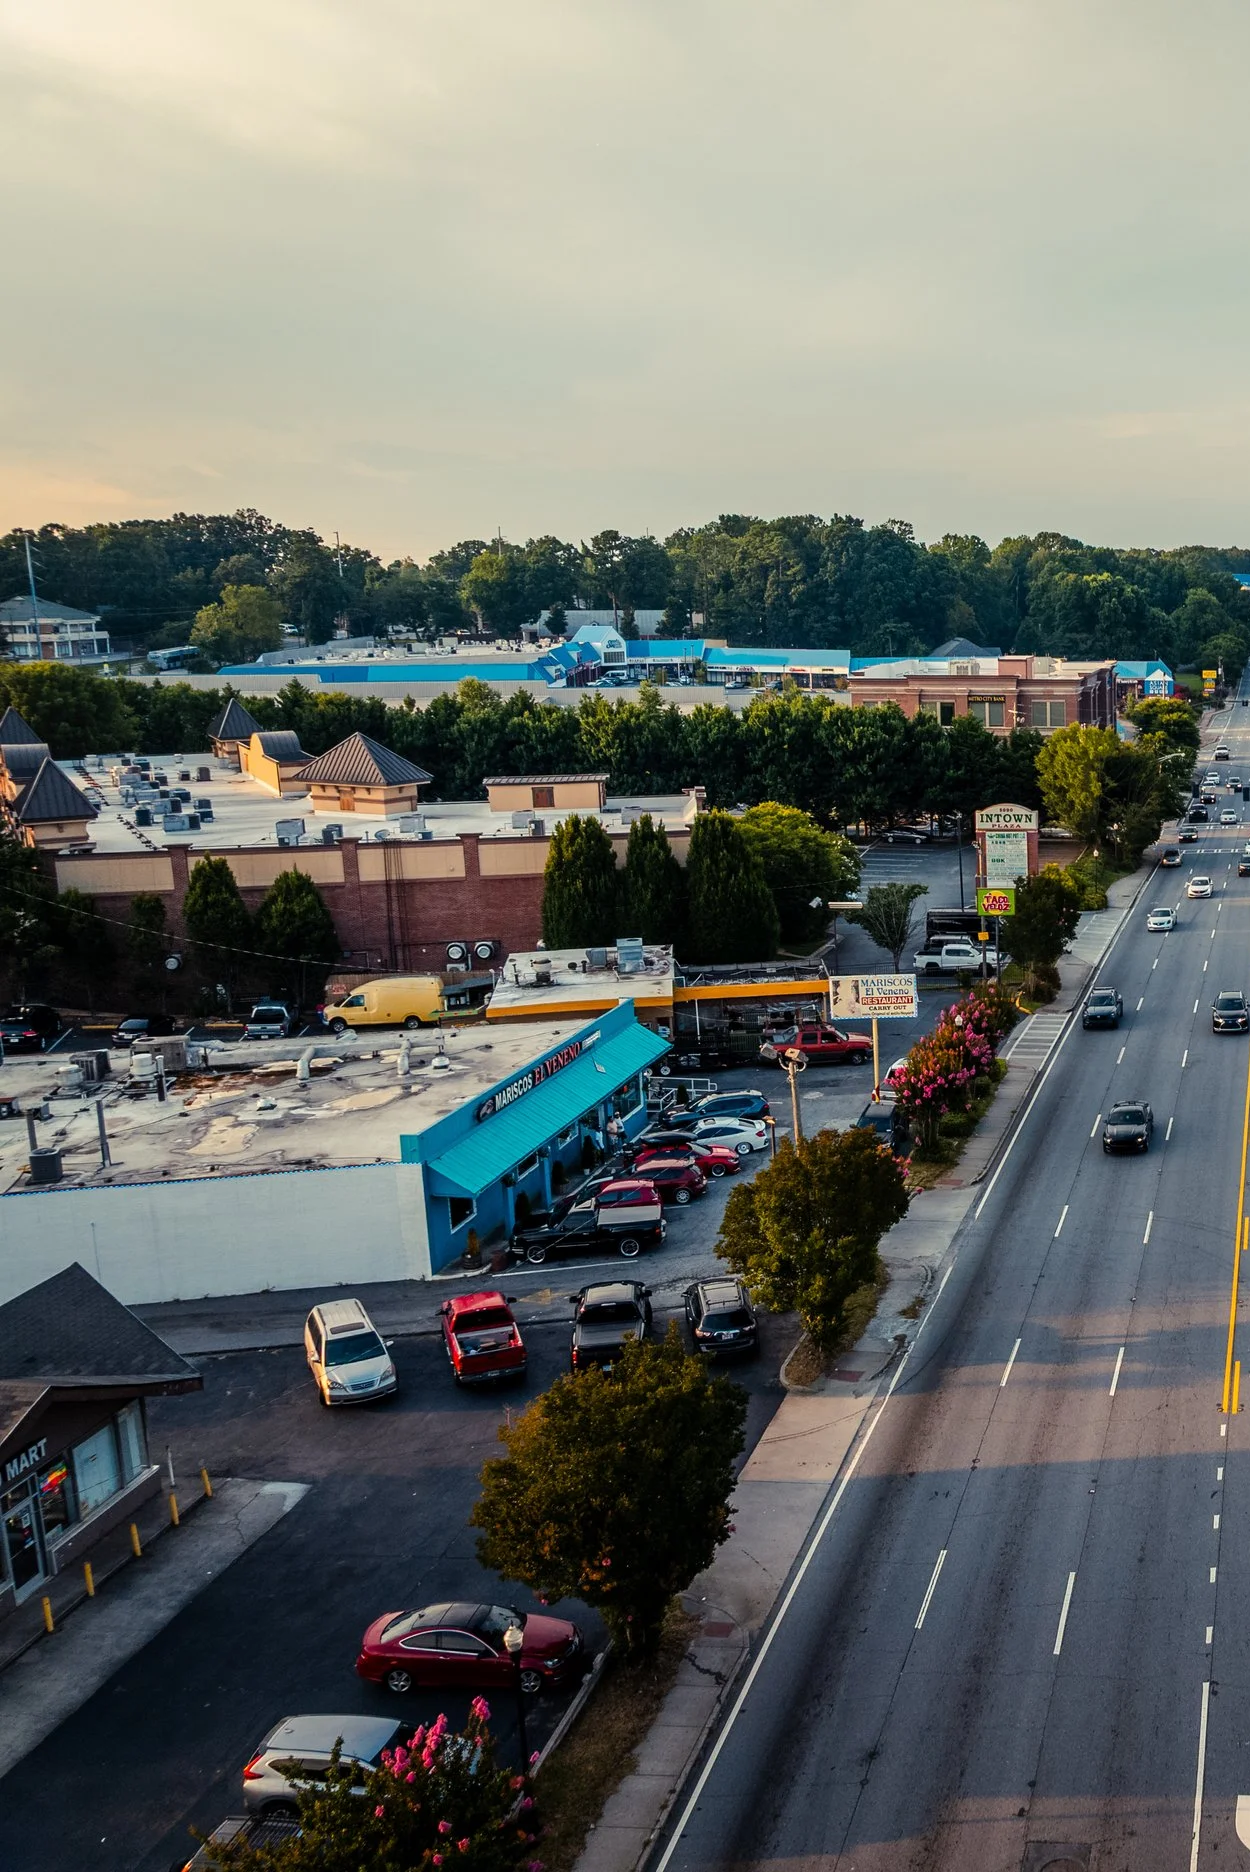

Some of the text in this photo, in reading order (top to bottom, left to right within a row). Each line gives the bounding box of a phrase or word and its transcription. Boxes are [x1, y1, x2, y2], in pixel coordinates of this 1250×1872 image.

[980, 814, 1032, 823] INTOWN
[984, 895, 1009, 904] TACO
[861, 978, 913, 987] MARISCOS
[865, 987, 909, 996] El Veneno
[495, 1041, 580, 1112] MARISCOS EL VENENO
[5, 1437, 48, 1482] MART
